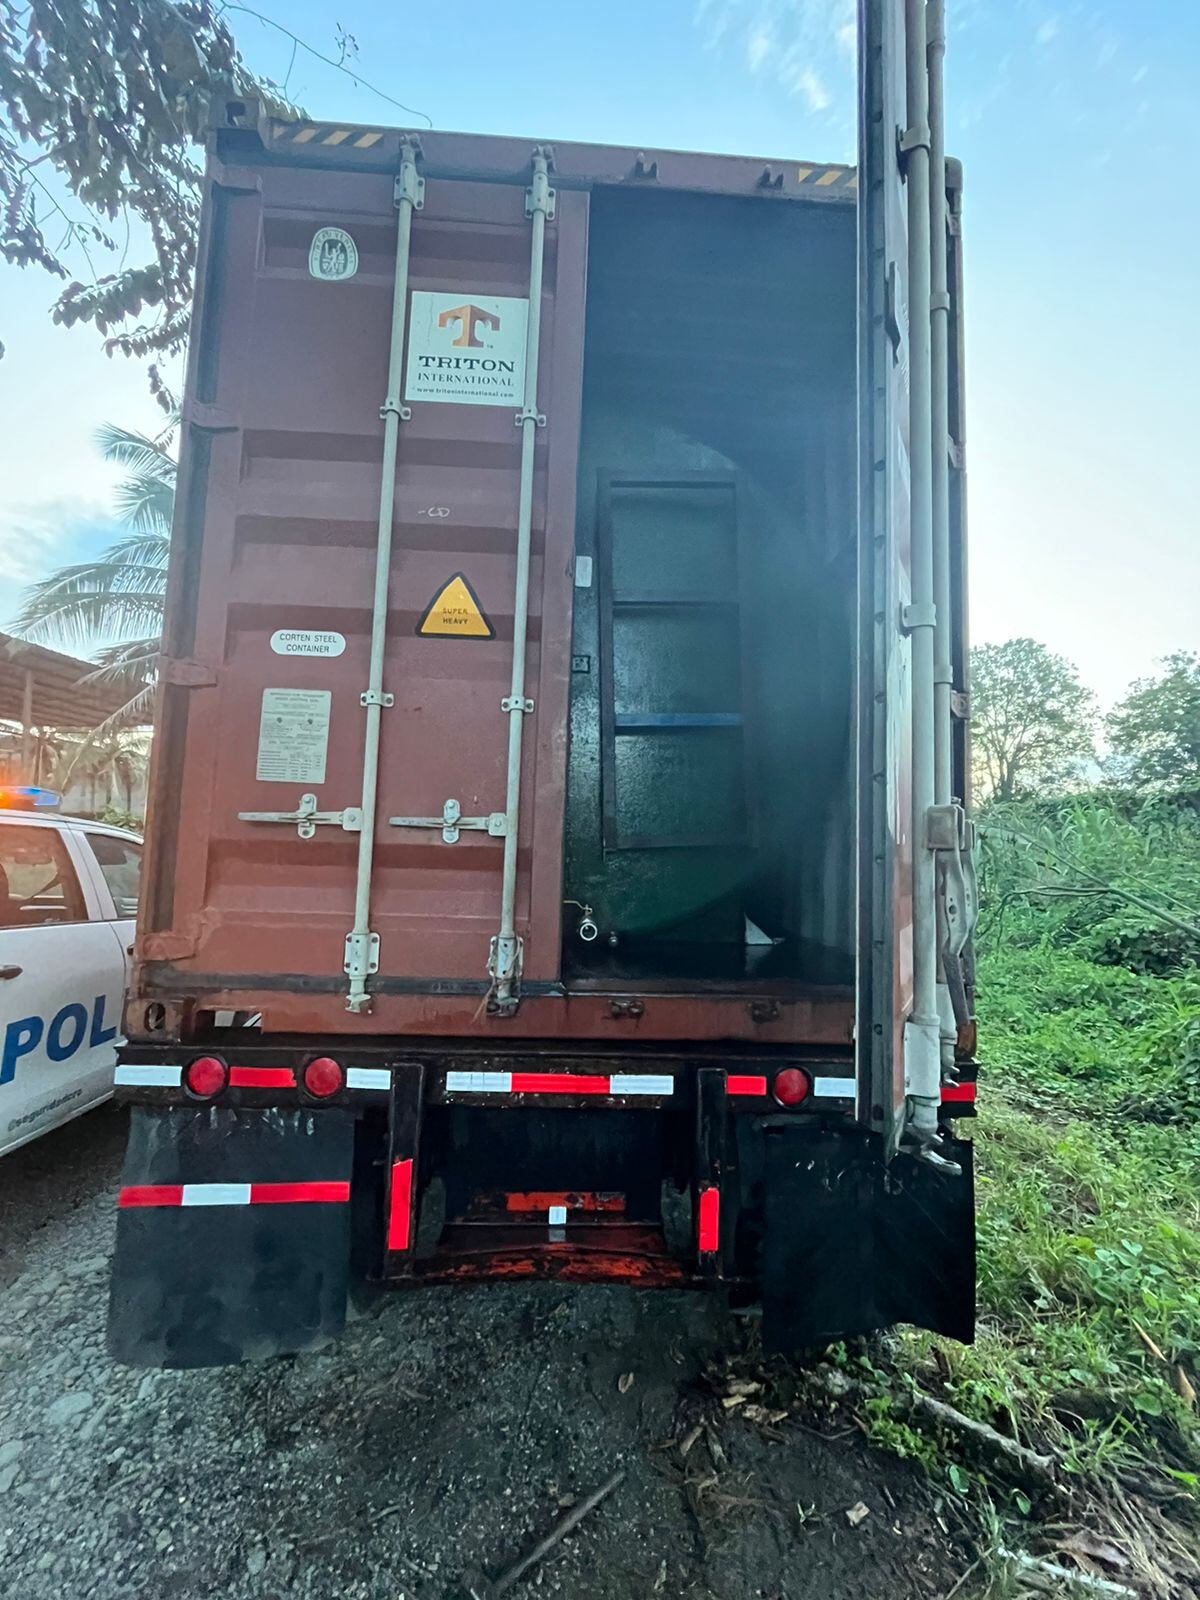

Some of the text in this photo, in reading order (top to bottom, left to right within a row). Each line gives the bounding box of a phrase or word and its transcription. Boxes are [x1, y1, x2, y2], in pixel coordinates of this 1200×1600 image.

[418, 355, 515, 372] TRITON
[417, 372, 514, 387] INTERNATIONAL
[442, 607, 468, 615] SUPER
[442, 617, 468, 625] HEAVY
[279, 632, 337, 644] CORTEN STEEL
[286, 643, 330, 653] CONTAINER
[0, 994, 117, 1087] POL
